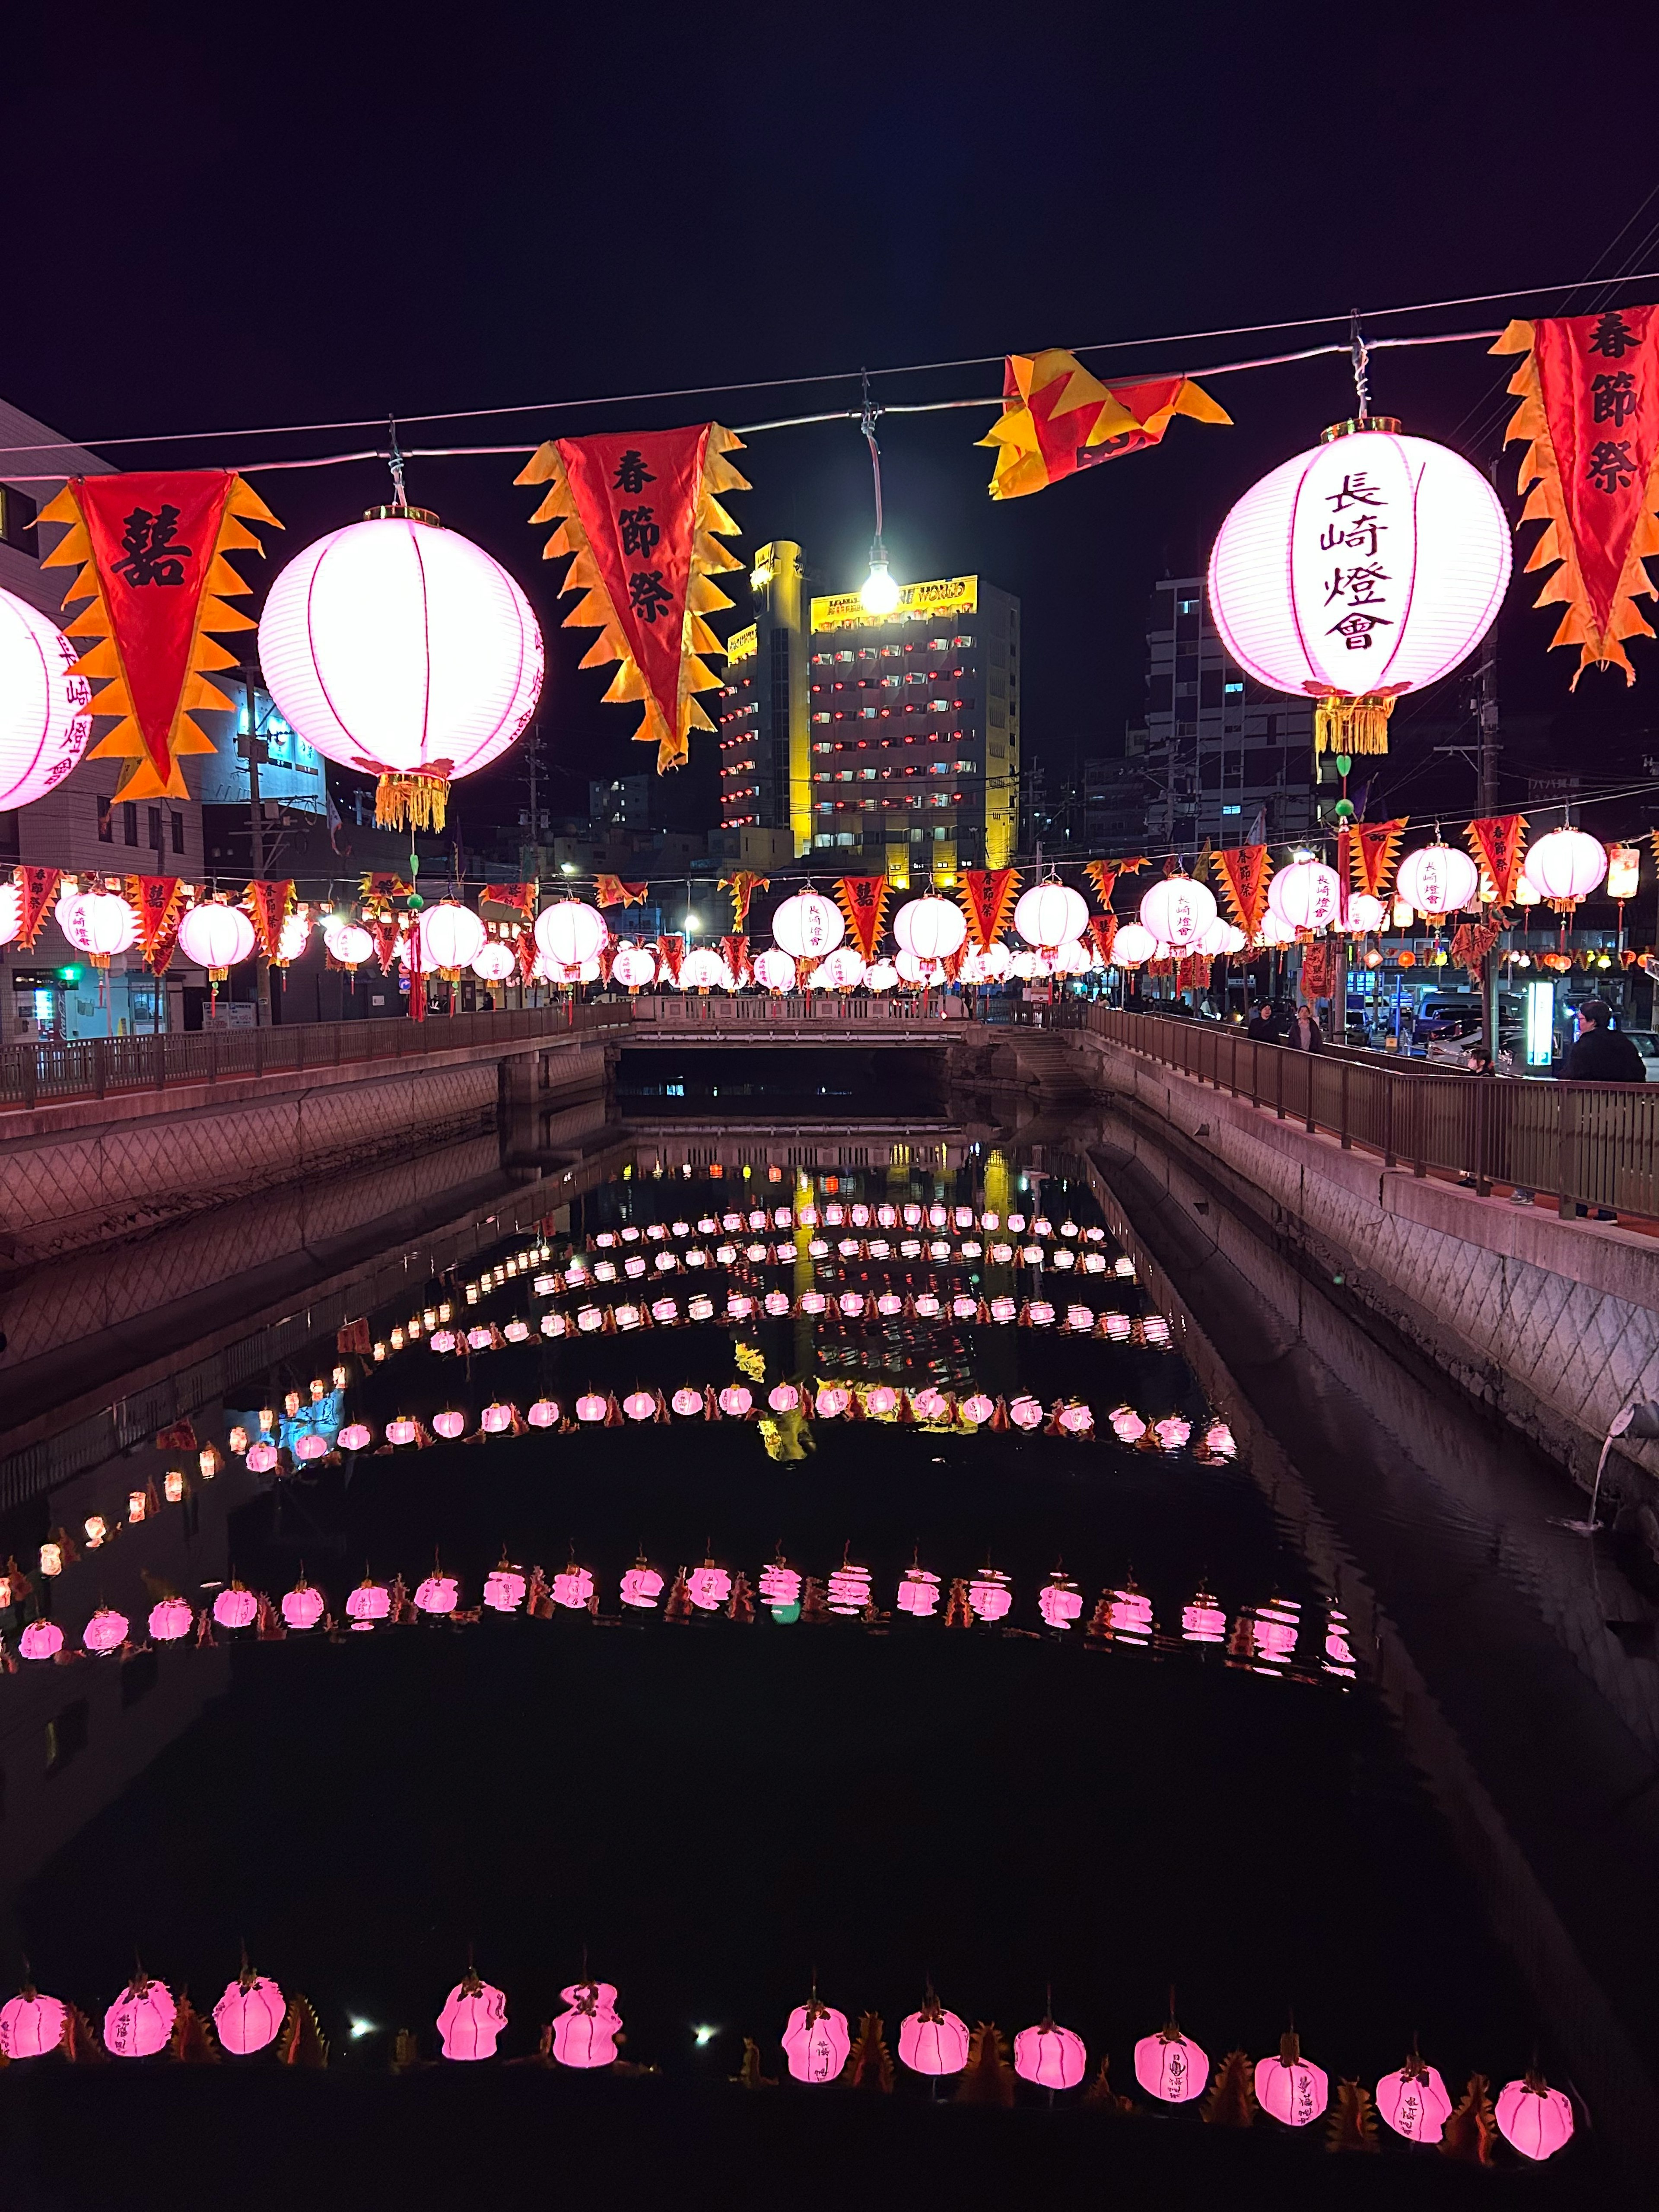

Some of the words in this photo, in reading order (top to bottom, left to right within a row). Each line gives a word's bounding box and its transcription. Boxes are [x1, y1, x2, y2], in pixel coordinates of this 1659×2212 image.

[1588, 312, 1643, 493] 春節祭
[111, 504, 193, 588] 囍
[613, 450, 674, 623] 春節祭
[1320, 472, 1394, 649] 長崎燈會
[918, 582, 965, 602] WORLD
[1237, 849, 1253, 897] 春節祭
[1493, 826, 1508, 872] 春節祭
[854, 881, 875, 907] 囍
[981, 873, 997, 917] 春節祭
